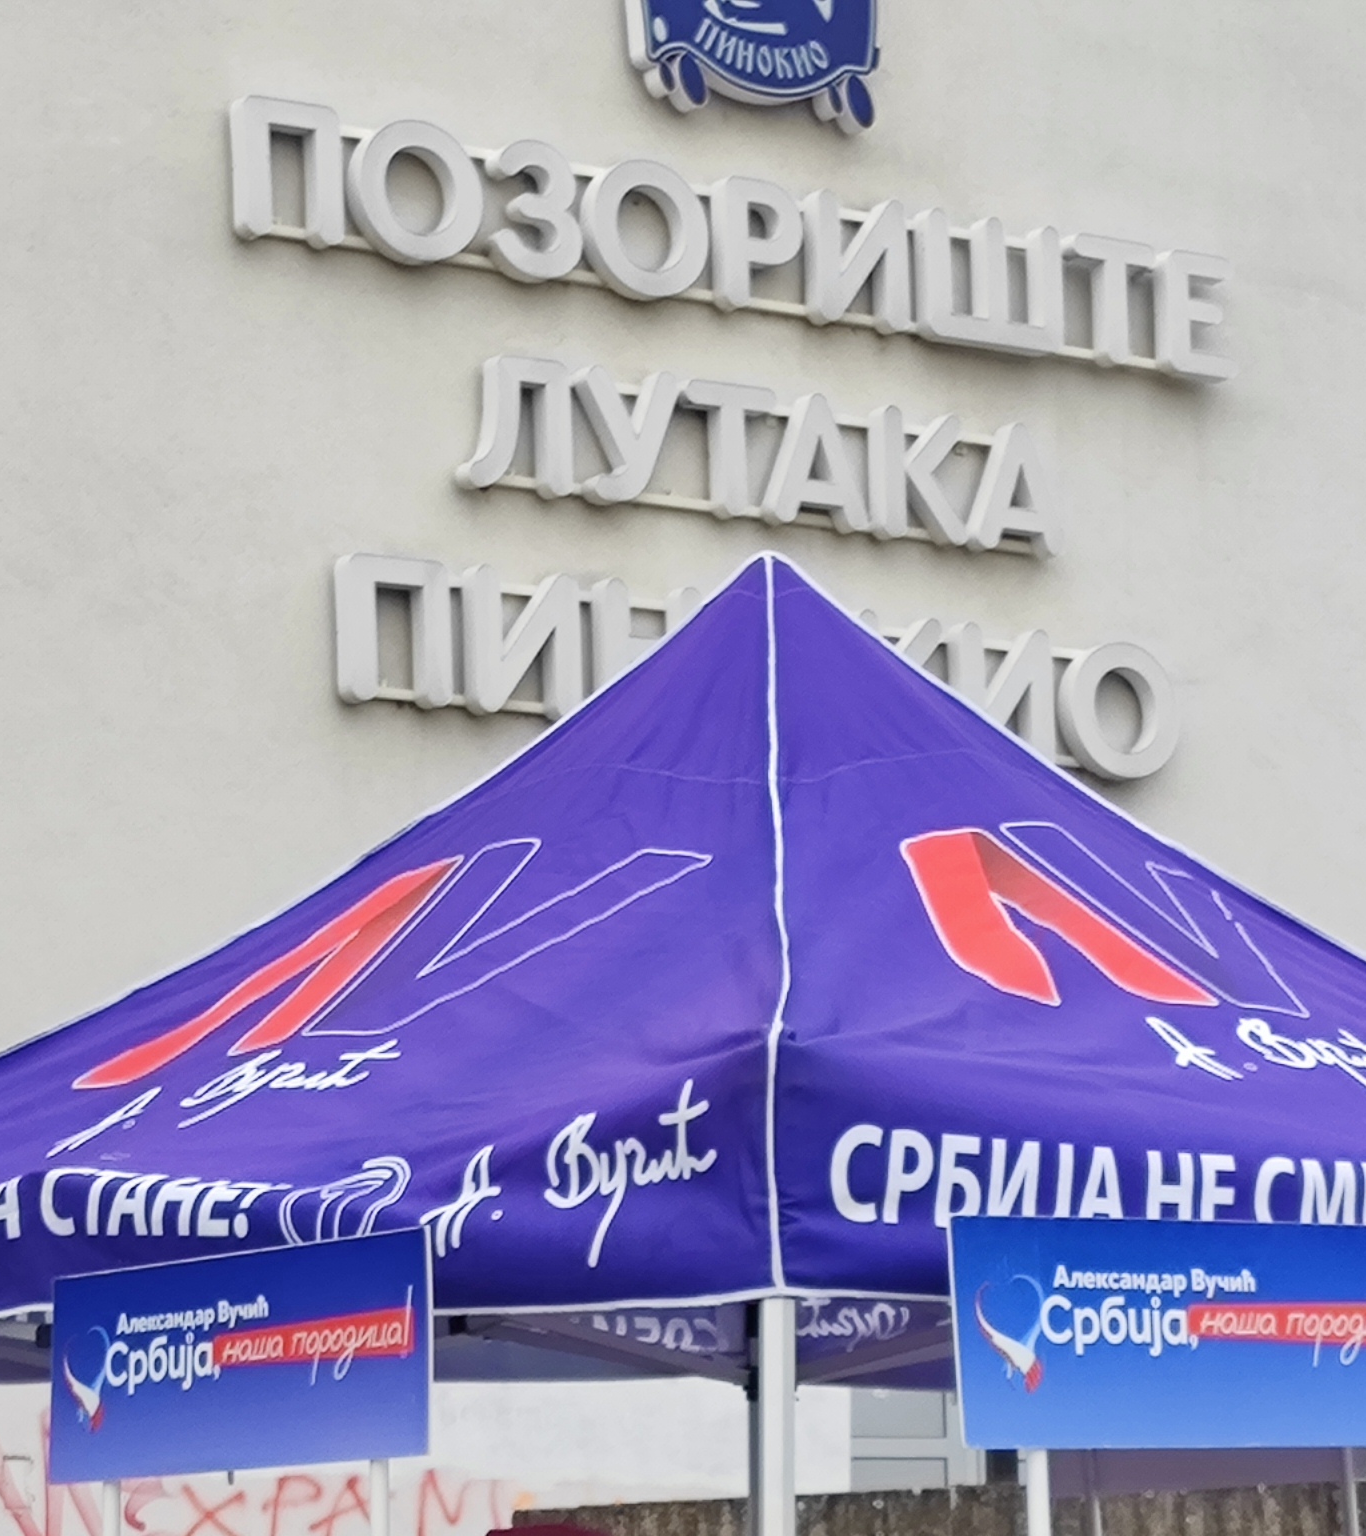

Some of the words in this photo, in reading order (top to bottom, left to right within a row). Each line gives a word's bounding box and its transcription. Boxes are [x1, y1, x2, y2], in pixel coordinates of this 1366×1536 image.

[693, 18, 829, 79] ПИНОКИО
[231, 96, 1234, 384] ПОЗОРИШТЕ
[454, 354, 1056, 558] ЛУТАКА
[830, 1124, 1125, 1228] СРБИЈА
[1146, 1150, 1235, 1220] НЕ
[1053, 1265, 1187, 1296] Александар
[1191, 1267, 1257, 1299] Вучић
[116, 1305, 215, 1336] Александар
[218, 1294, 269, 1328] Вучић
[1039, 1295, 1198, 1357] Србија,
[1200, 1309, 1278, 1337] наша
[105, 1331, 220, 1395] Србија,
[221, 1334, 283, 1362] наша
